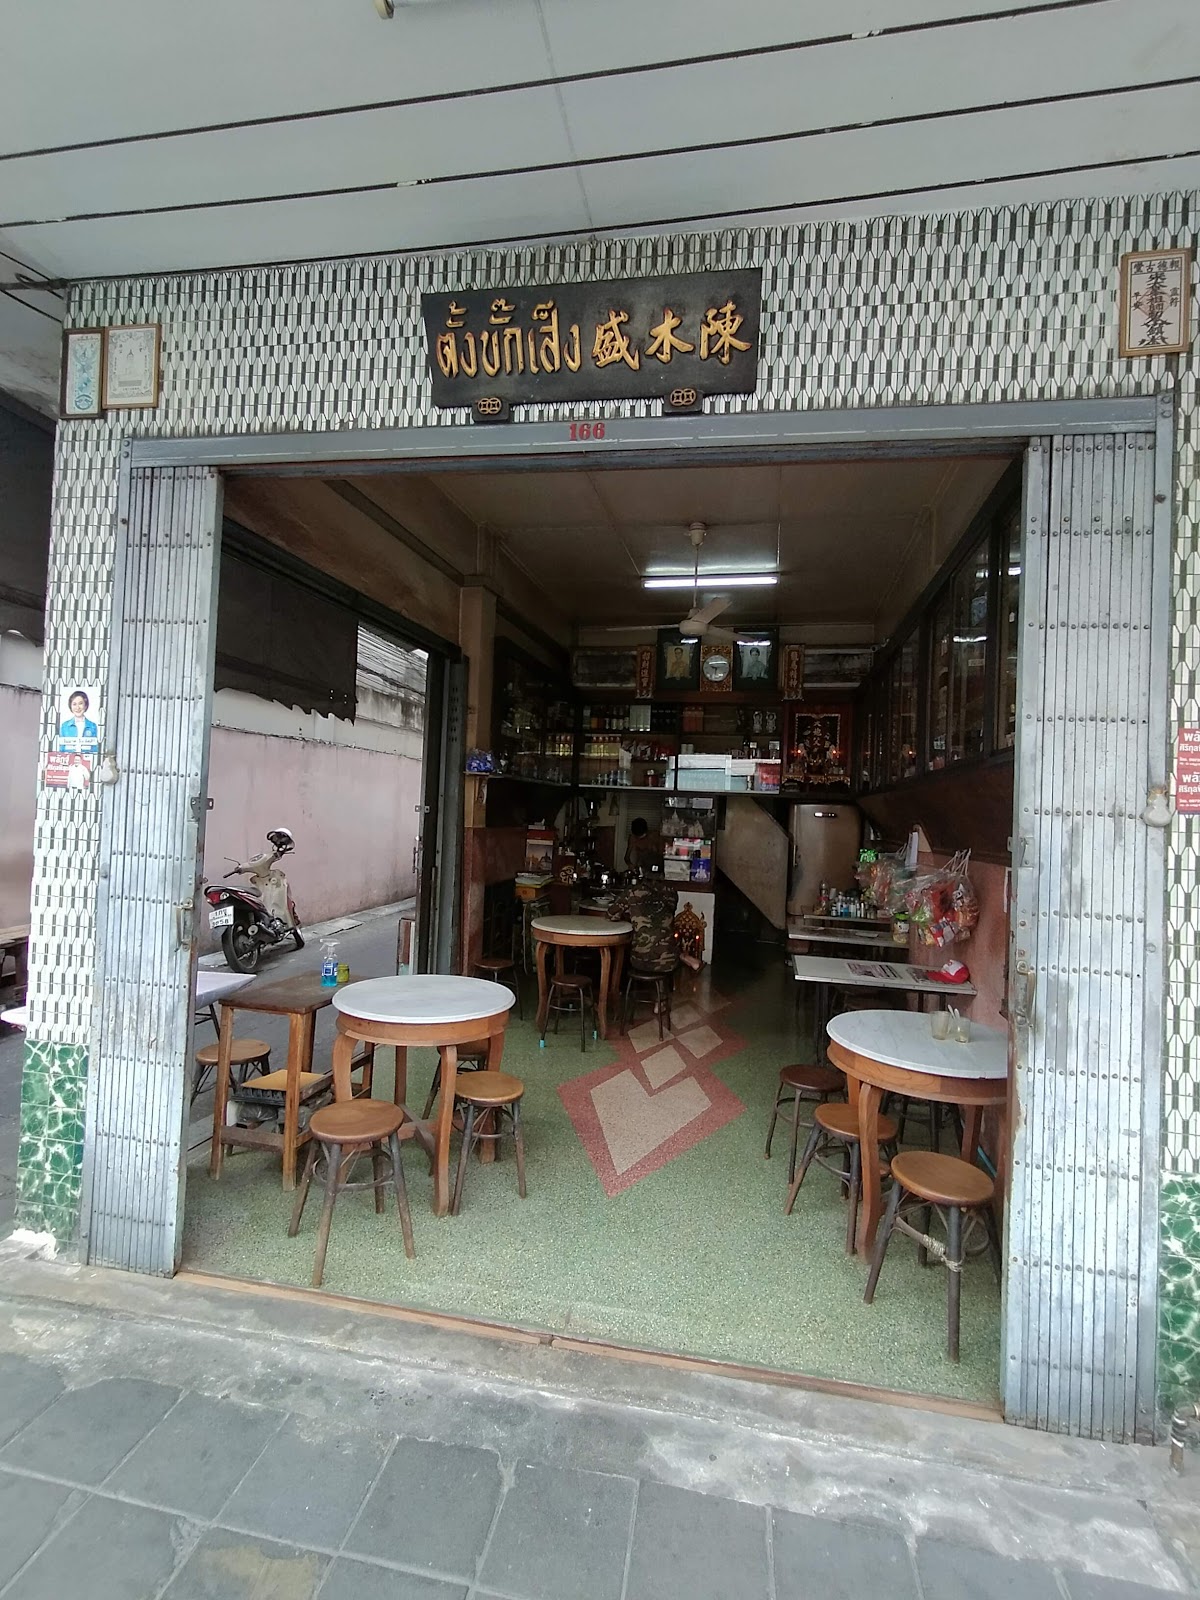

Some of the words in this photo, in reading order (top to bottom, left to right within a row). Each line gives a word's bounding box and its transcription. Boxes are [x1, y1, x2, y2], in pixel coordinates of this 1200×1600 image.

[436, 298, 582, 378] ตั้งบั๊กเส็ง
[569, 422, 605, 441] 166
